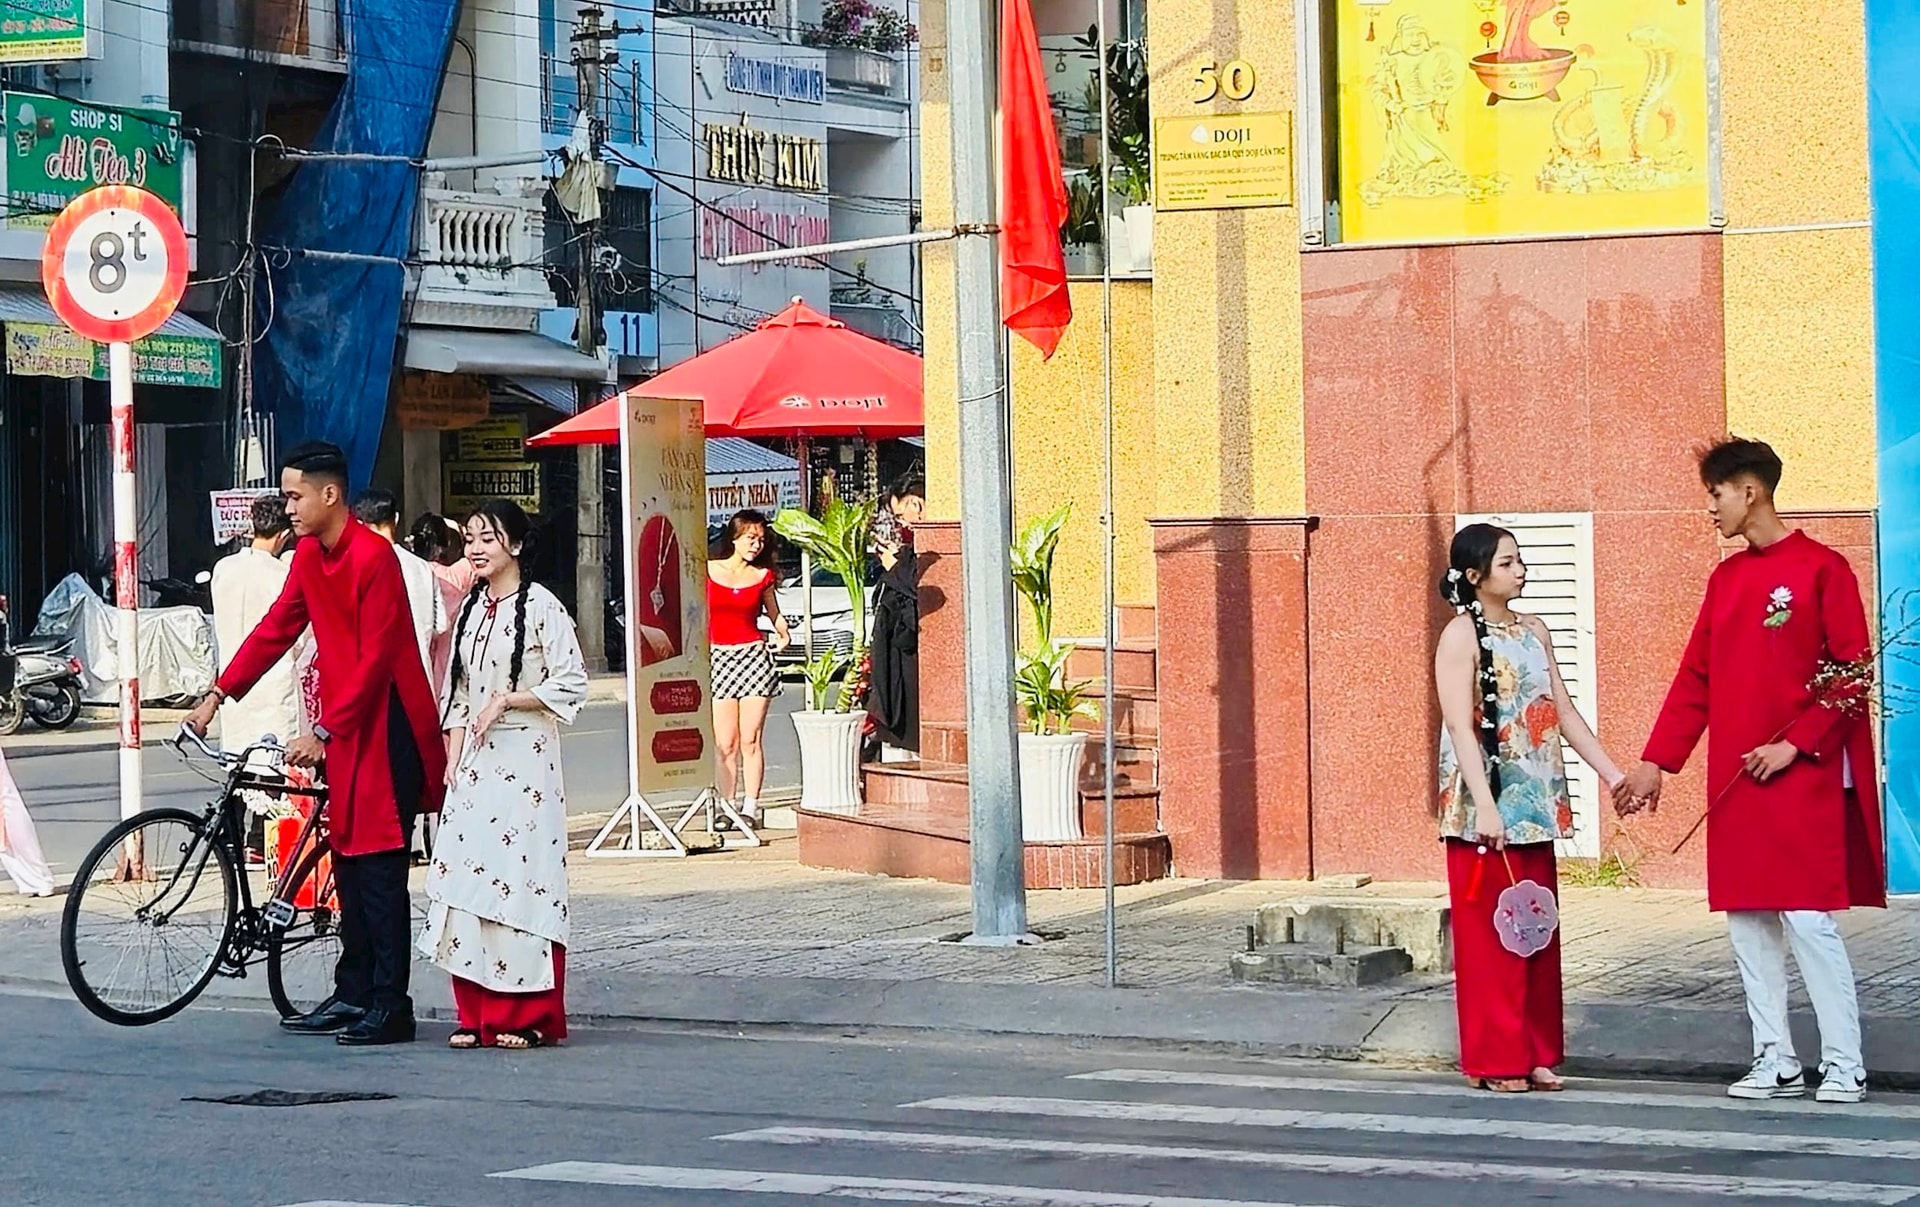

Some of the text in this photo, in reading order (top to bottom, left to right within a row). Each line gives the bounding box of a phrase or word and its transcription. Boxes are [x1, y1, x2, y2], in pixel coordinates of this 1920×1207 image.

[1194, 60, 1256, 104] 50
[71, 109, 106, 129] SHOP
[1214, 128, 1251, 145] DOJI
[133, 148, 147, 186] 3
[774, 133, 821, 190] KIM
[621, 314, 640, 355] 11
[453, 471, 520, 483] WESTERN
[473, 483, 521, 494] UNION
[708, 477, 746, 509] TUYẾT
[748, 478, 779, 507] NHÂN
